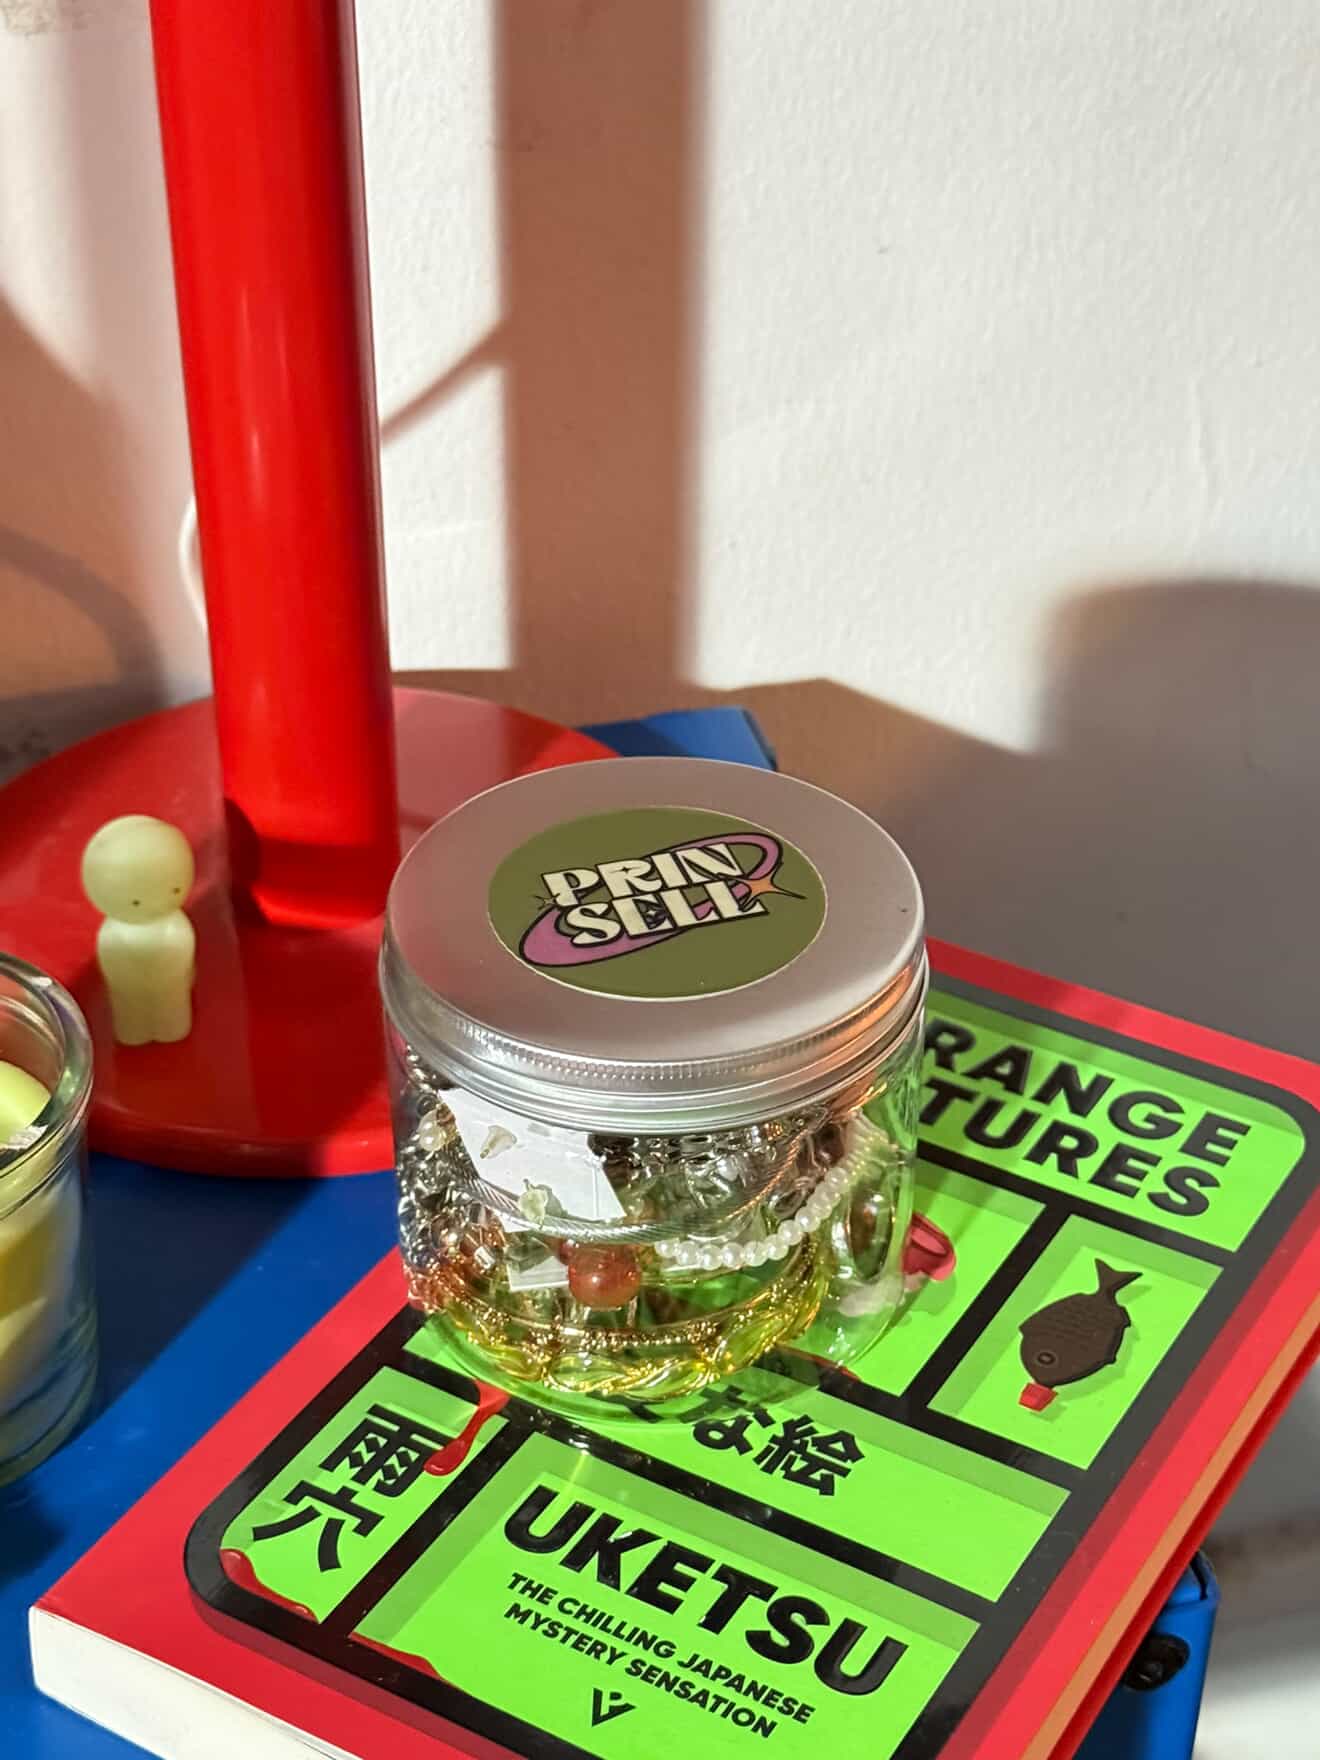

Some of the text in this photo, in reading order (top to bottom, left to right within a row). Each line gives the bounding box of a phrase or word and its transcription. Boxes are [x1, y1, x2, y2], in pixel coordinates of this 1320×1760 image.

[541, 842, 744, 908] PRIN
[564, 879, 769, 947] SELL
[918, 1076, 1221, 1217] TURES
[923, 1017, 1252, 1168] RANGE
[251, 1403, 454, 1573] 雨穴
[610, 1383, 866, 1497] な絵
[503, 1484, 910, 1697] UKETSU
[506, 1571, 816, 1725] THE CHILLING JAPANESE
[503, 1602, 778, 1739] MYSTERY SENSATION
